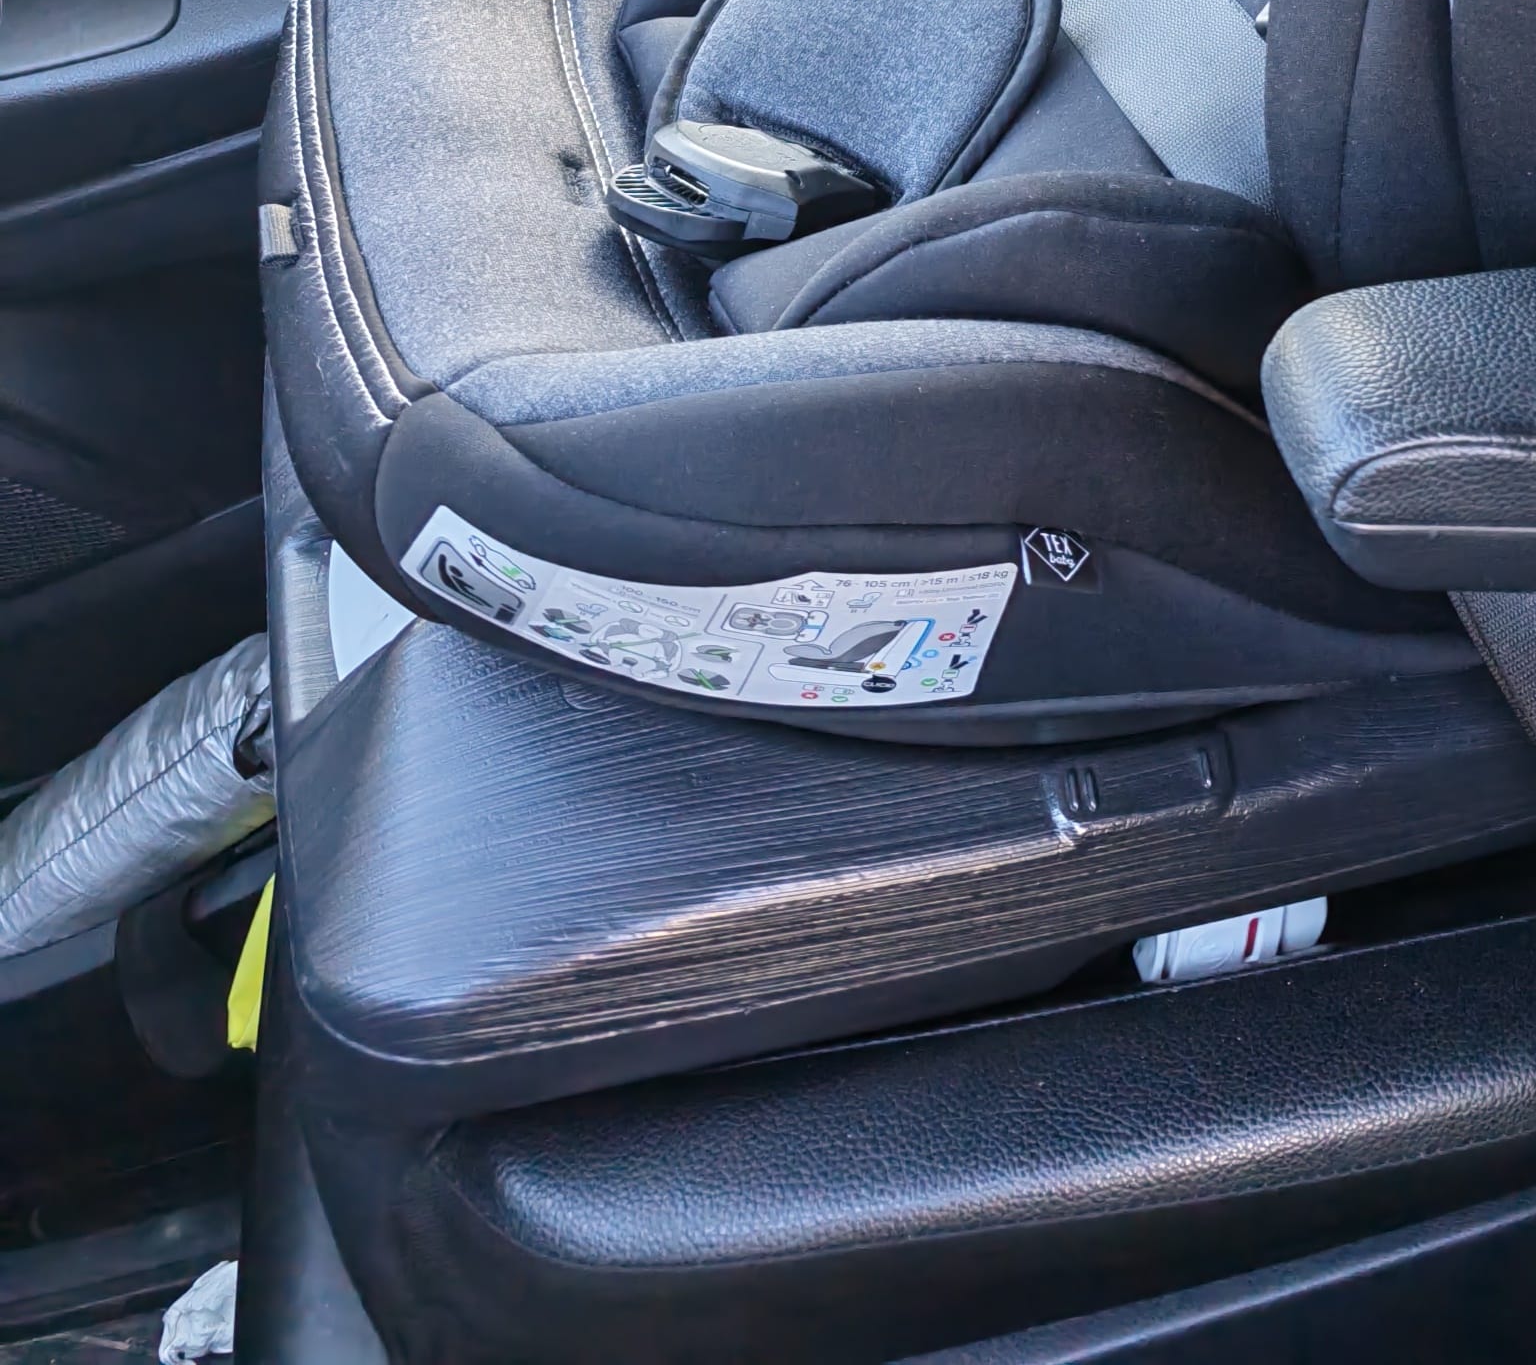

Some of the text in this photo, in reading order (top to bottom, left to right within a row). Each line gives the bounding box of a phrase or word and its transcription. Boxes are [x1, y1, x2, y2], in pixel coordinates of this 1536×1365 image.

[1040, 532, 1073, 556] TEX
[1049, 552, 1075, 569] baby
[835, 579, 850, 588] 76
[864, 580, 887, 588] 105
[993, 570, 1009, 579] kg
